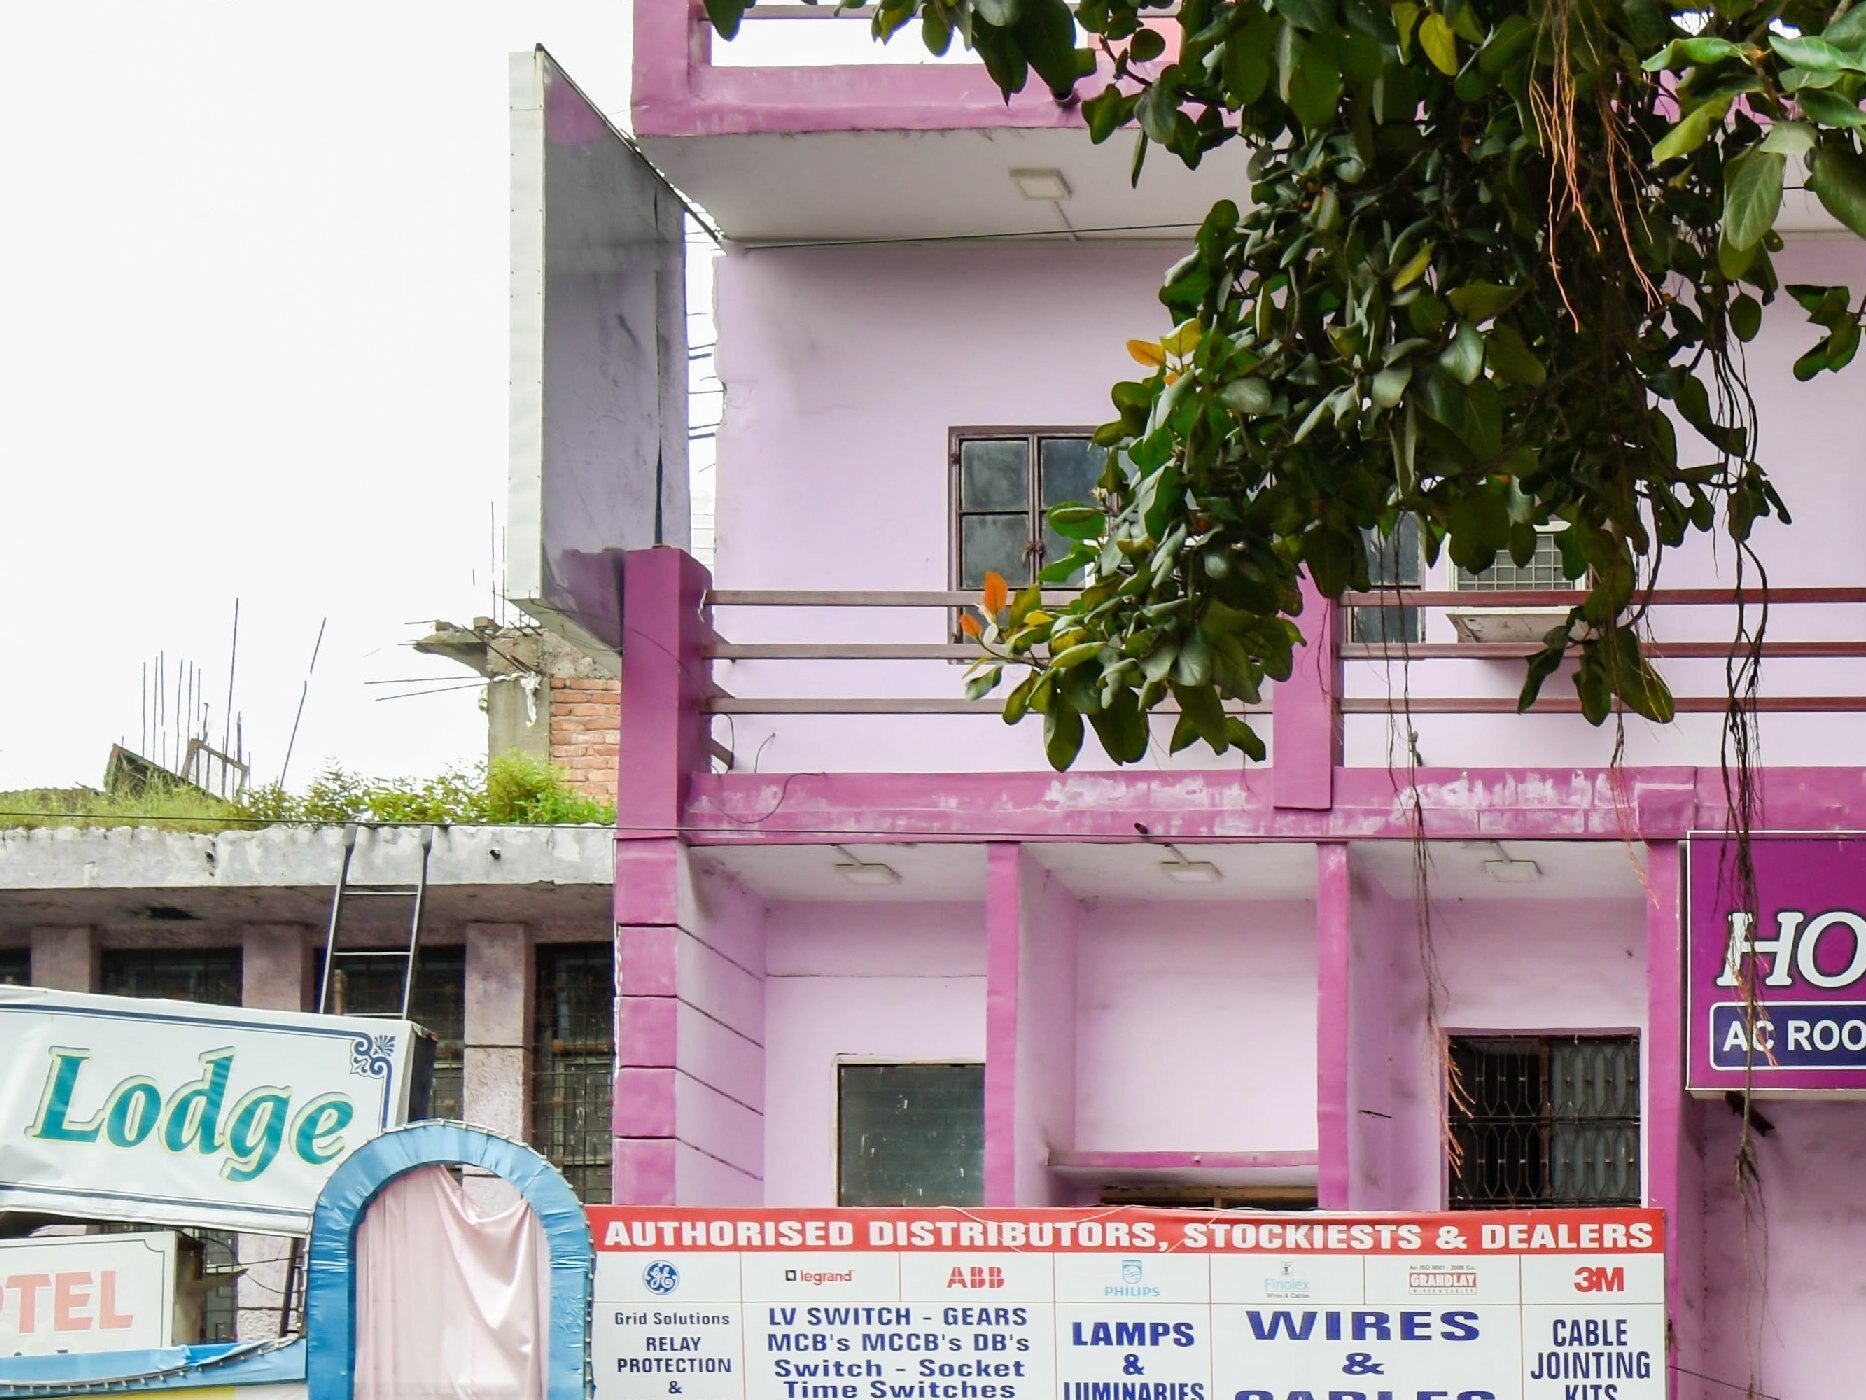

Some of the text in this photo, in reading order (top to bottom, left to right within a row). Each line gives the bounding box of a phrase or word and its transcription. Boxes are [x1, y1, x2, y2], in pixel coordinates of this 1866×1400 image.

[1723, 1020, 1777, 1052] AC
[26, 1045, 355, 1182] Lodge
[604, 1219, 1654, 1251] AUTHORISED DISTRIBUTORS, STOCKIESTS & DEALERS
[800, 1268, 852, 1286] legrand
[946, 1267, 1006, 1289] ABB
[1265, 1278, 1309, 1291] Finolex
[1411, 1273, 1476, 1287] GRANDLAY
[1573, 1267, 1625, 1292] 3M
[0, 1270, 133, 1334] TEL
[1104, 1286, 1160, 1297] PHILIPS
[614, 1312, 731, 1326] Grid Solutions
[768, 1307, 1028, 1326] LV SWITCH GEARS
[1246, 1310, 1480, 1342] WIRES
[767, 1333, 1030, 1353] MCB's MCCB's DB's
[1072, 1322, 1195, 1348] LAMPS
[1551, 1318, 1629, 1347] CABLE
[646, 1336, 702, 1352] RELAY
[616, 1357, 733, 1374] PROTECTION
[774, 1359, 1026, 1379] Switch Socket
[1122, 1354, 1145, 1376] &
[1341, 1352, 1385, 1376] &
[1529, 1351, 1652, 1381] JOINTING
[667, 1380, 683, 1395] &
[784, 1381, 1016, 1399] Time Switches
